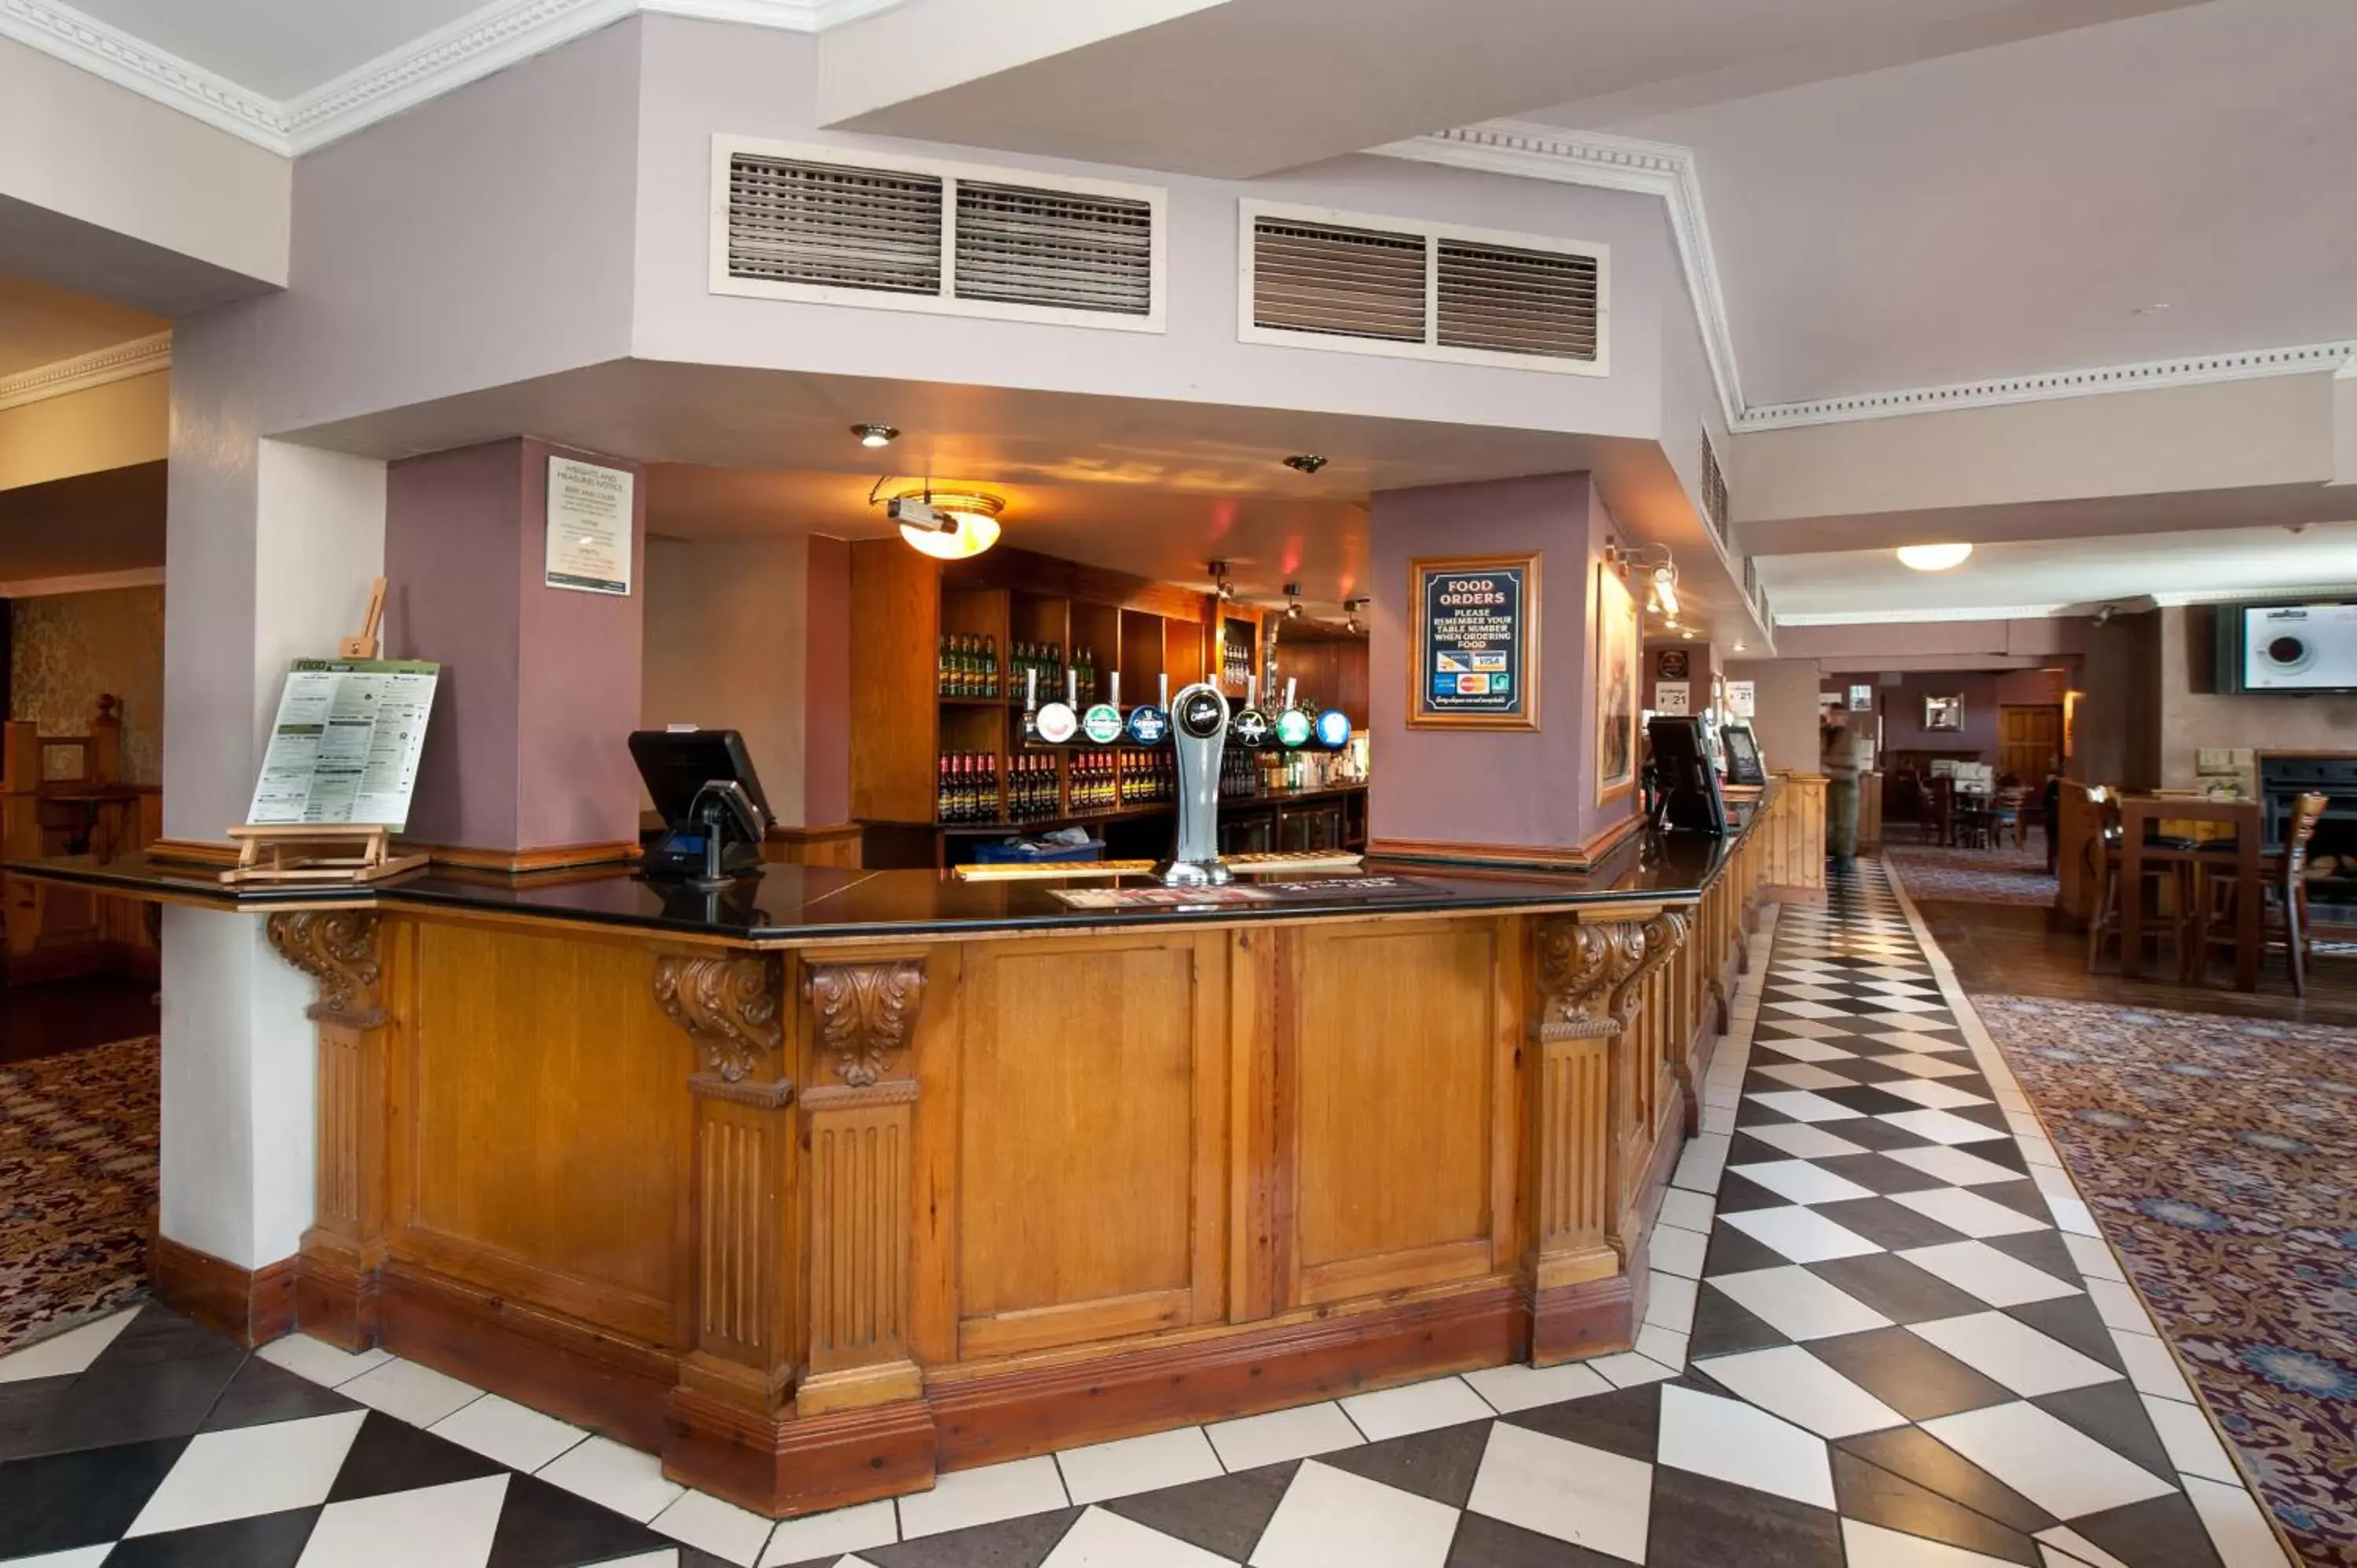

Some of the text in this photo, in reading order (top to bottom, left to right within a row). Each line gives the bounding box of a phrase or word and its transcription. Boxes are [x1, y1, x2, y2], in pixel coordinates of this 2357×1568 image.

[1448, 580, 1494, 592] FOOD
[1440, 592, 1505, 605] ORDERS
[1434, 616, 1512, 625] REMEMBER YOUR
[1436, 625, 1465, 633] TABLE
